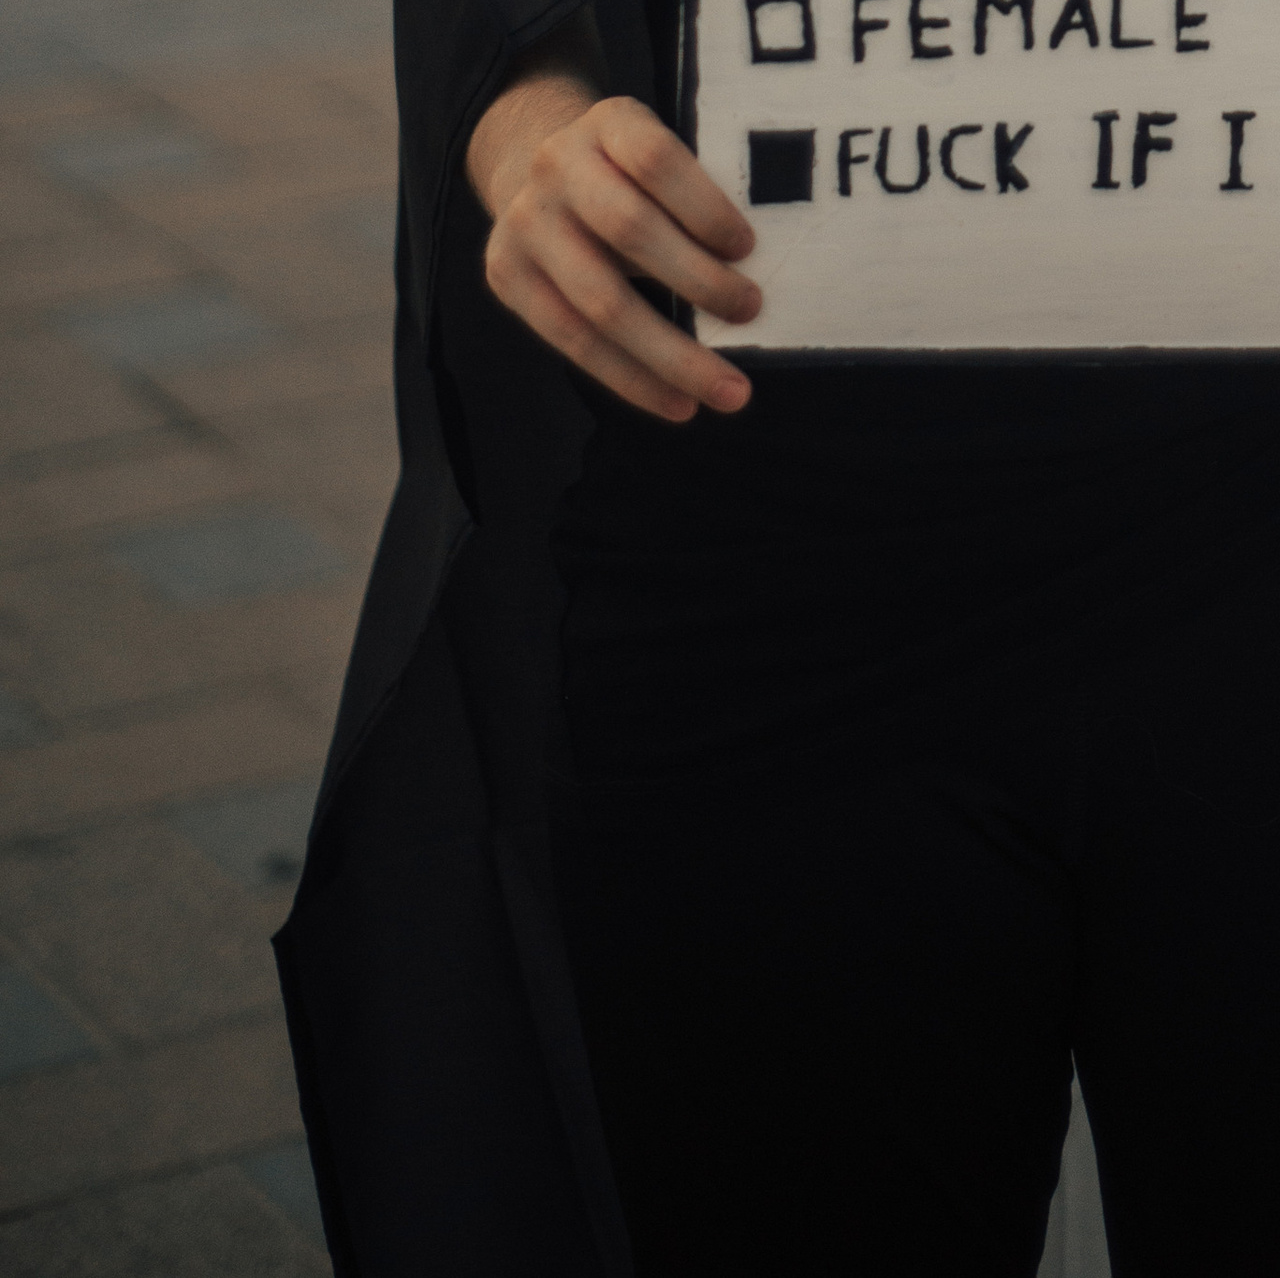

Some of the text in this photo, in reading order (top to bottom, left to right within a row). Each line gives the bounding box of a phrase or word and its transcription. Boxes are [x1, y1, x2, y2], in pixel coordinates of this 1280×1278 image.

[835, 121, 1036, 199] FUCK
[1090, 109, 1179, 192] IF
[1218, 109, 1258, 194] I
